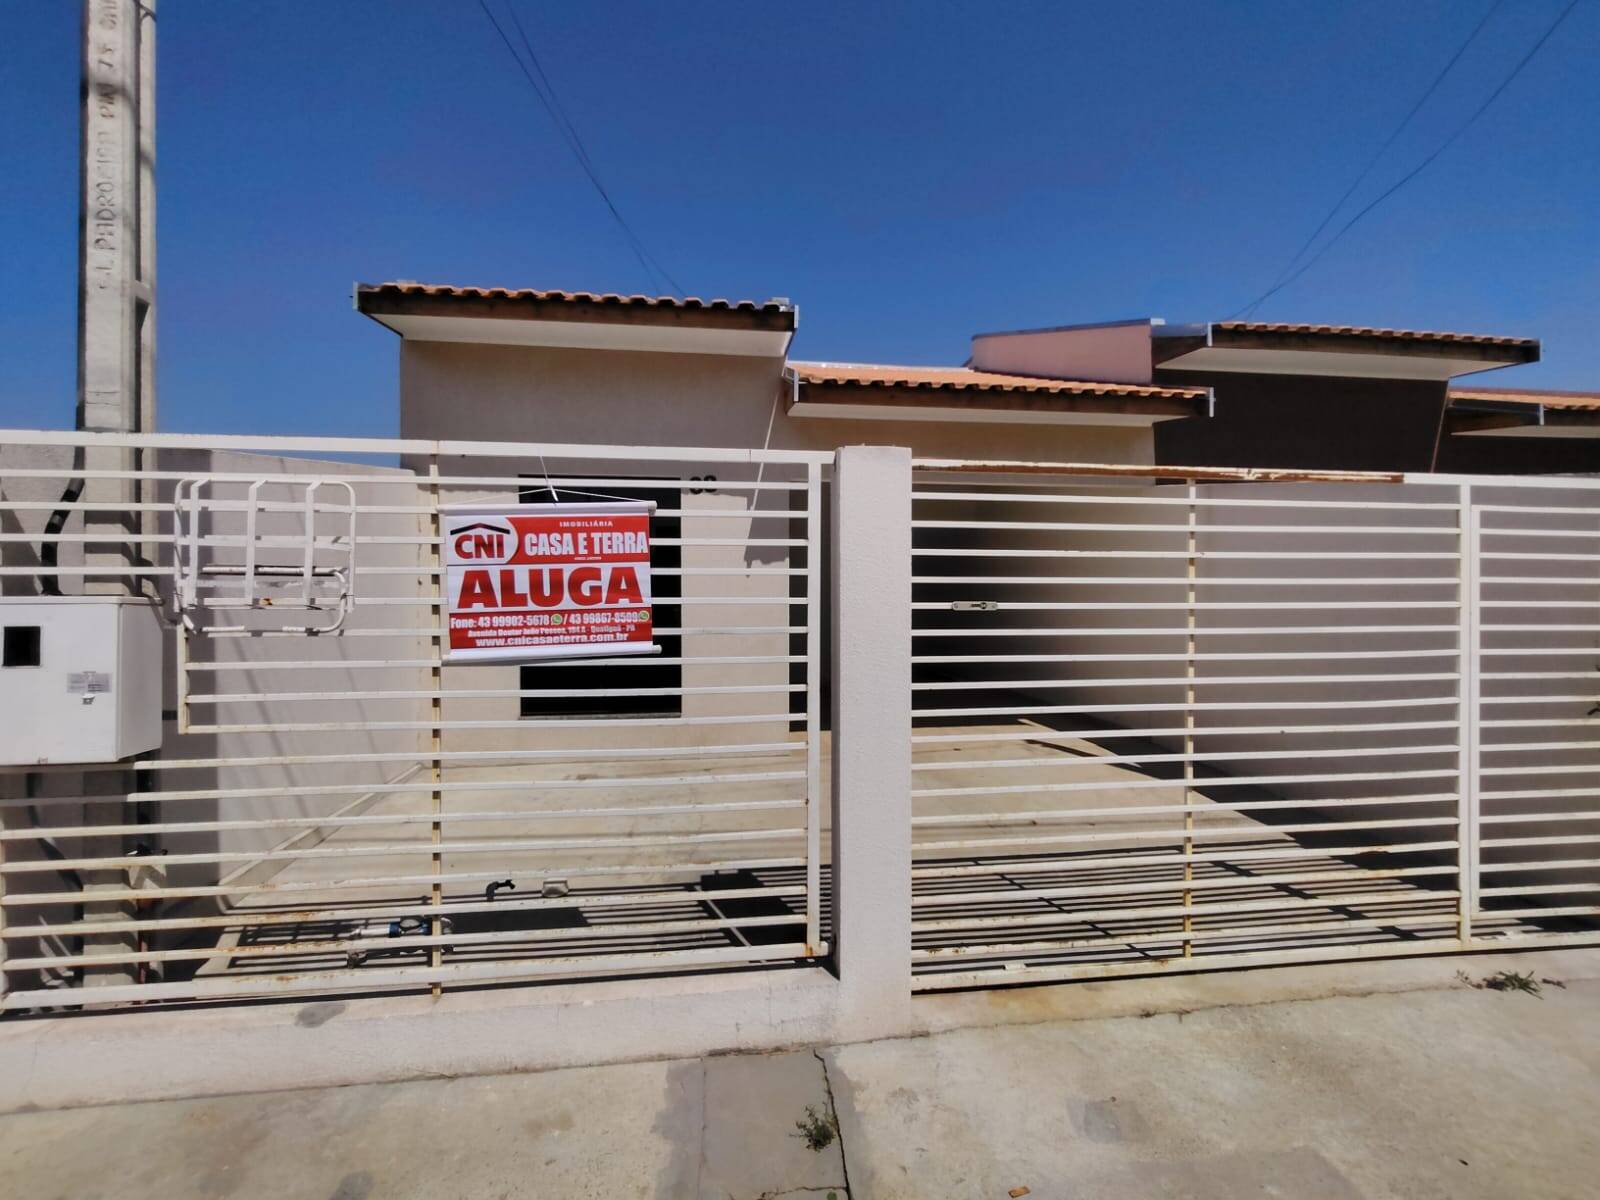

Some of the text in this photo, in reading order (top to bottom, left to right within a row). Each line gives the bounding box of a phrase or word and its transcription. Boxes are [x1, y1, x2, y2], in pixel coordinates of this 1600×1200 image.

[454, 534, 505, 559] CNI
[524, 531, 648, 556] CASA E TERRA
[457, 566, 643, 609] ALUGA
[450, 617, 477, 629] Fone:
[478, 616, 491, 628] 43
[492, 614, 549, 627] 99902-5678
[570, 613, 581, 625] 43
[475, 632, 628, 647] www.cnicasaeterra.com.br
